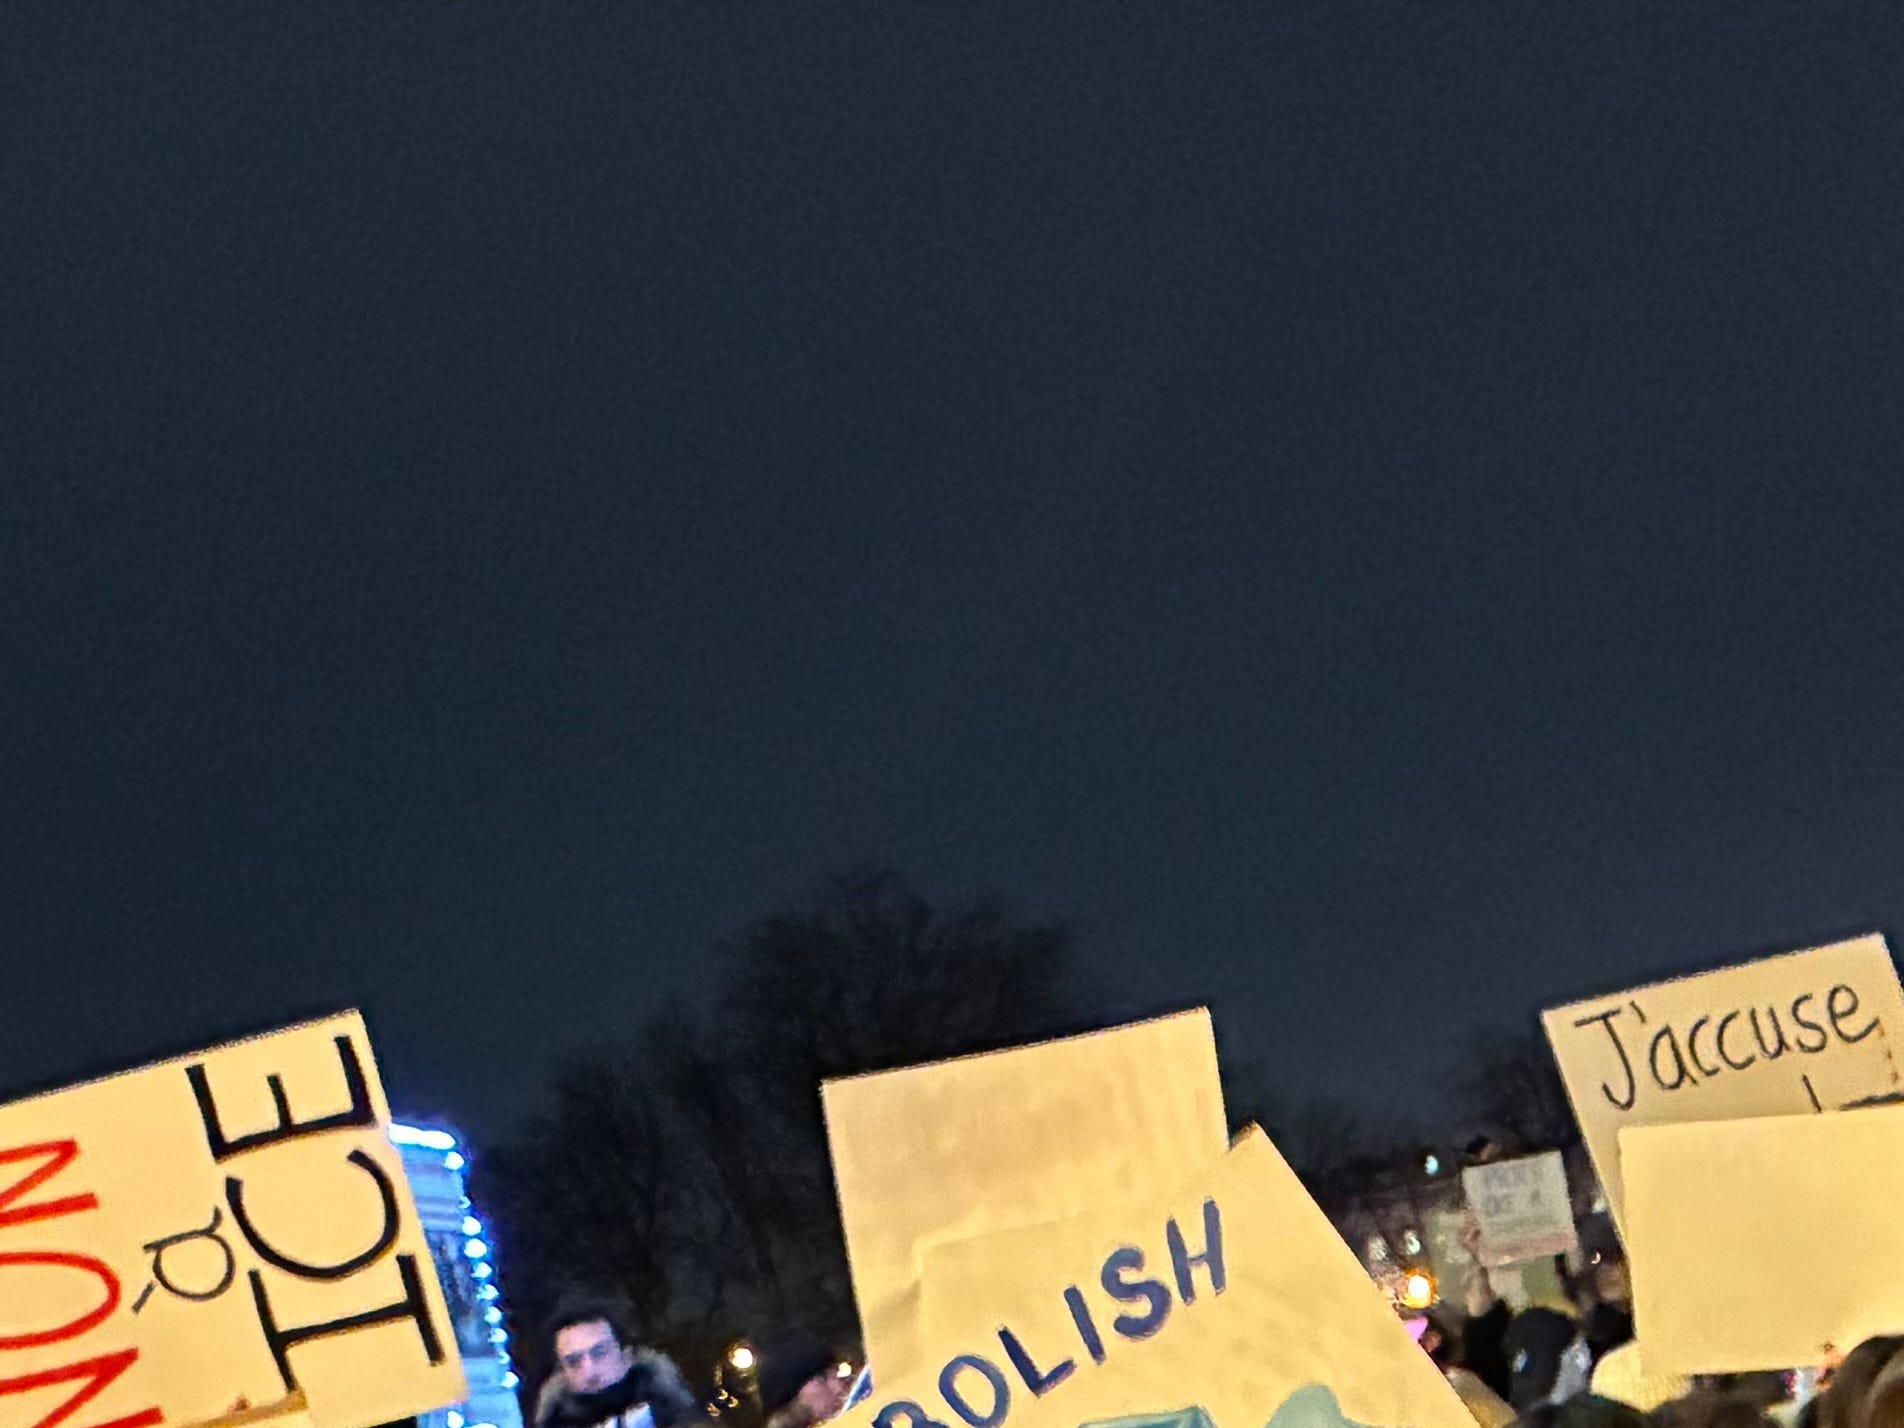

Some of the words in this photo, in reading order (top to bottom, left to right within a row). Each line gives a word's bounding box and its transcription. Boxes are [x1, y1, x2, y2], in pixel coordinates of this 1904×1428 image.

[1574, 982, 1882, 1112] J'accuse
[131, 1206, 237, 1316] à
[183, 1032, 448, 1394] ICE
